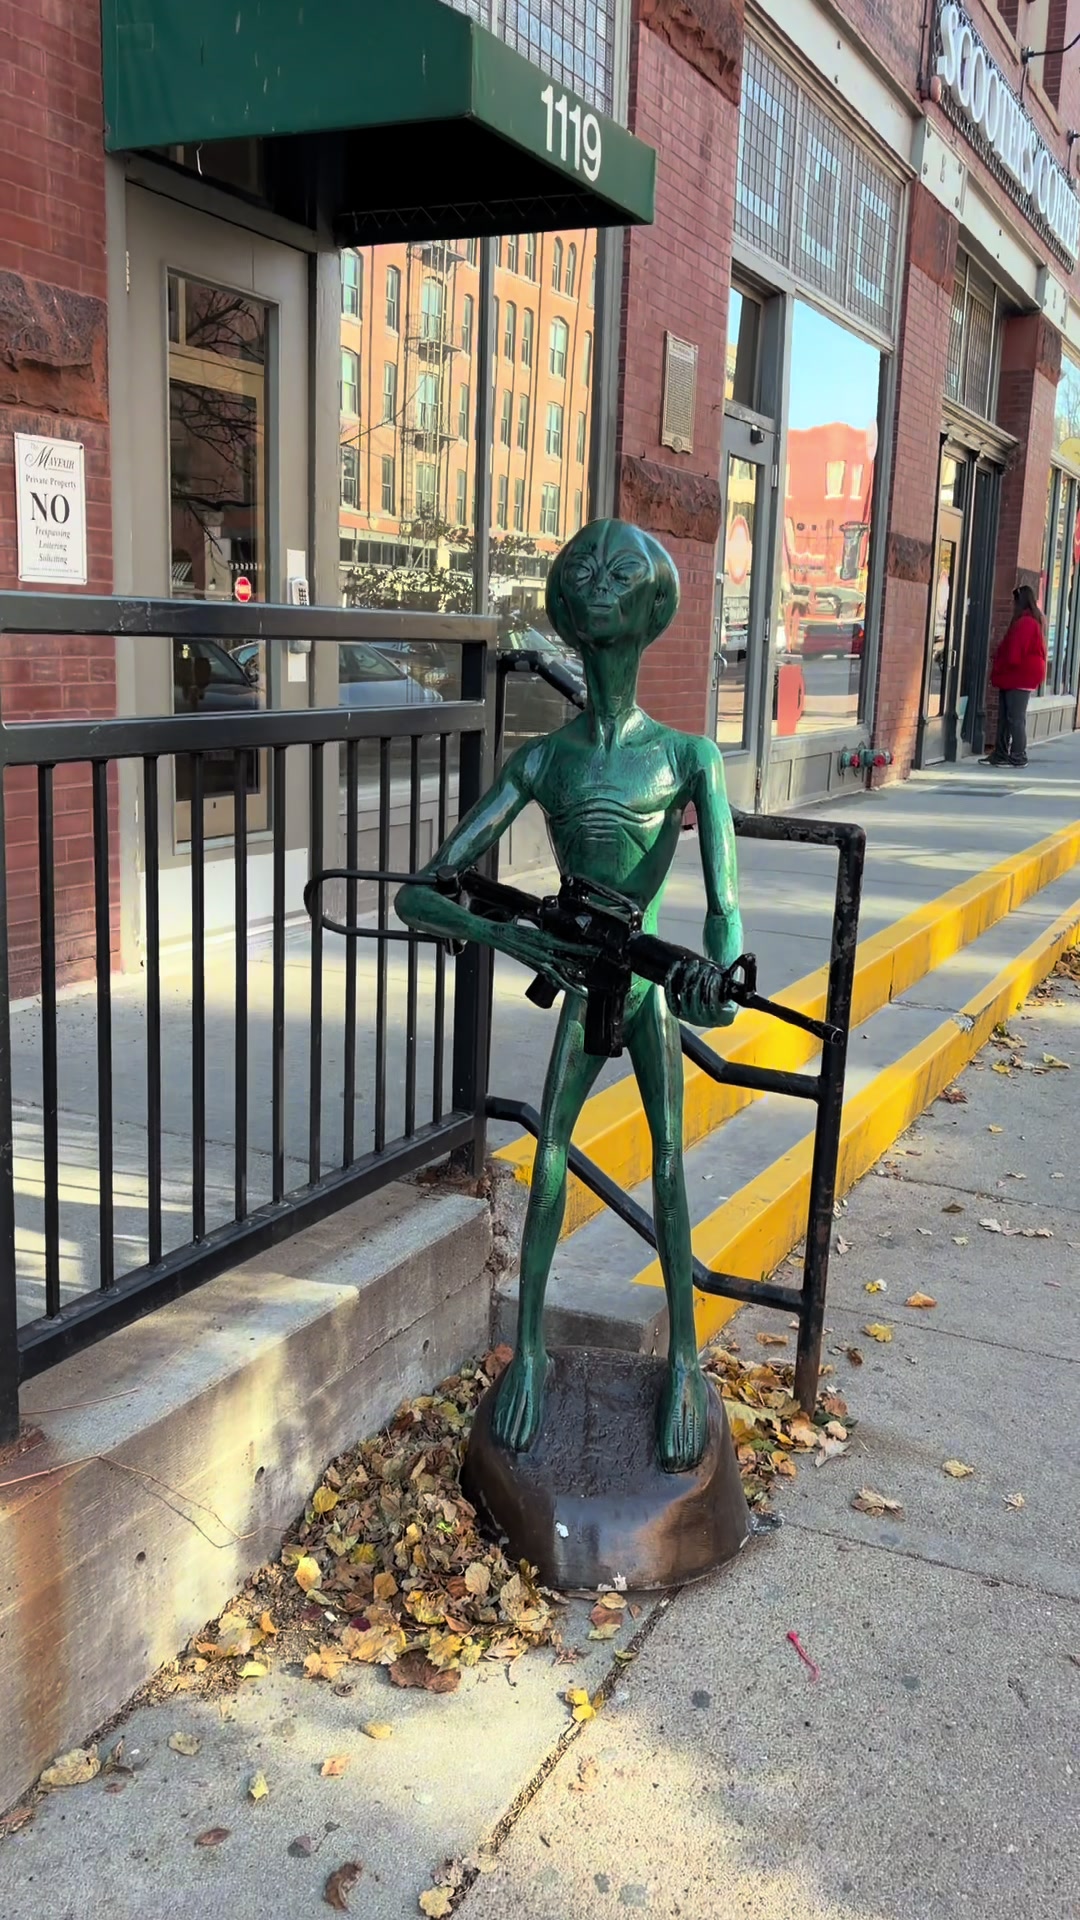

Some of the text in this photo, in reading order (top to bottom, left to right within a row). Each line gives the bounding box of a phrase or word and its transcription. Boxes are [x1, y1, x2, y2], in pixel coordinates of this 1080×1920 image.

[541, 84, 601, 181] 1119
[25, 474, 76, 491] Private Property
[30, 491, 70, 524] NO
[35, 526, 71, 539] Trespassing
[38, 540, 67, 552] Loitering
[38, 553, 68, 565] Soliciting
